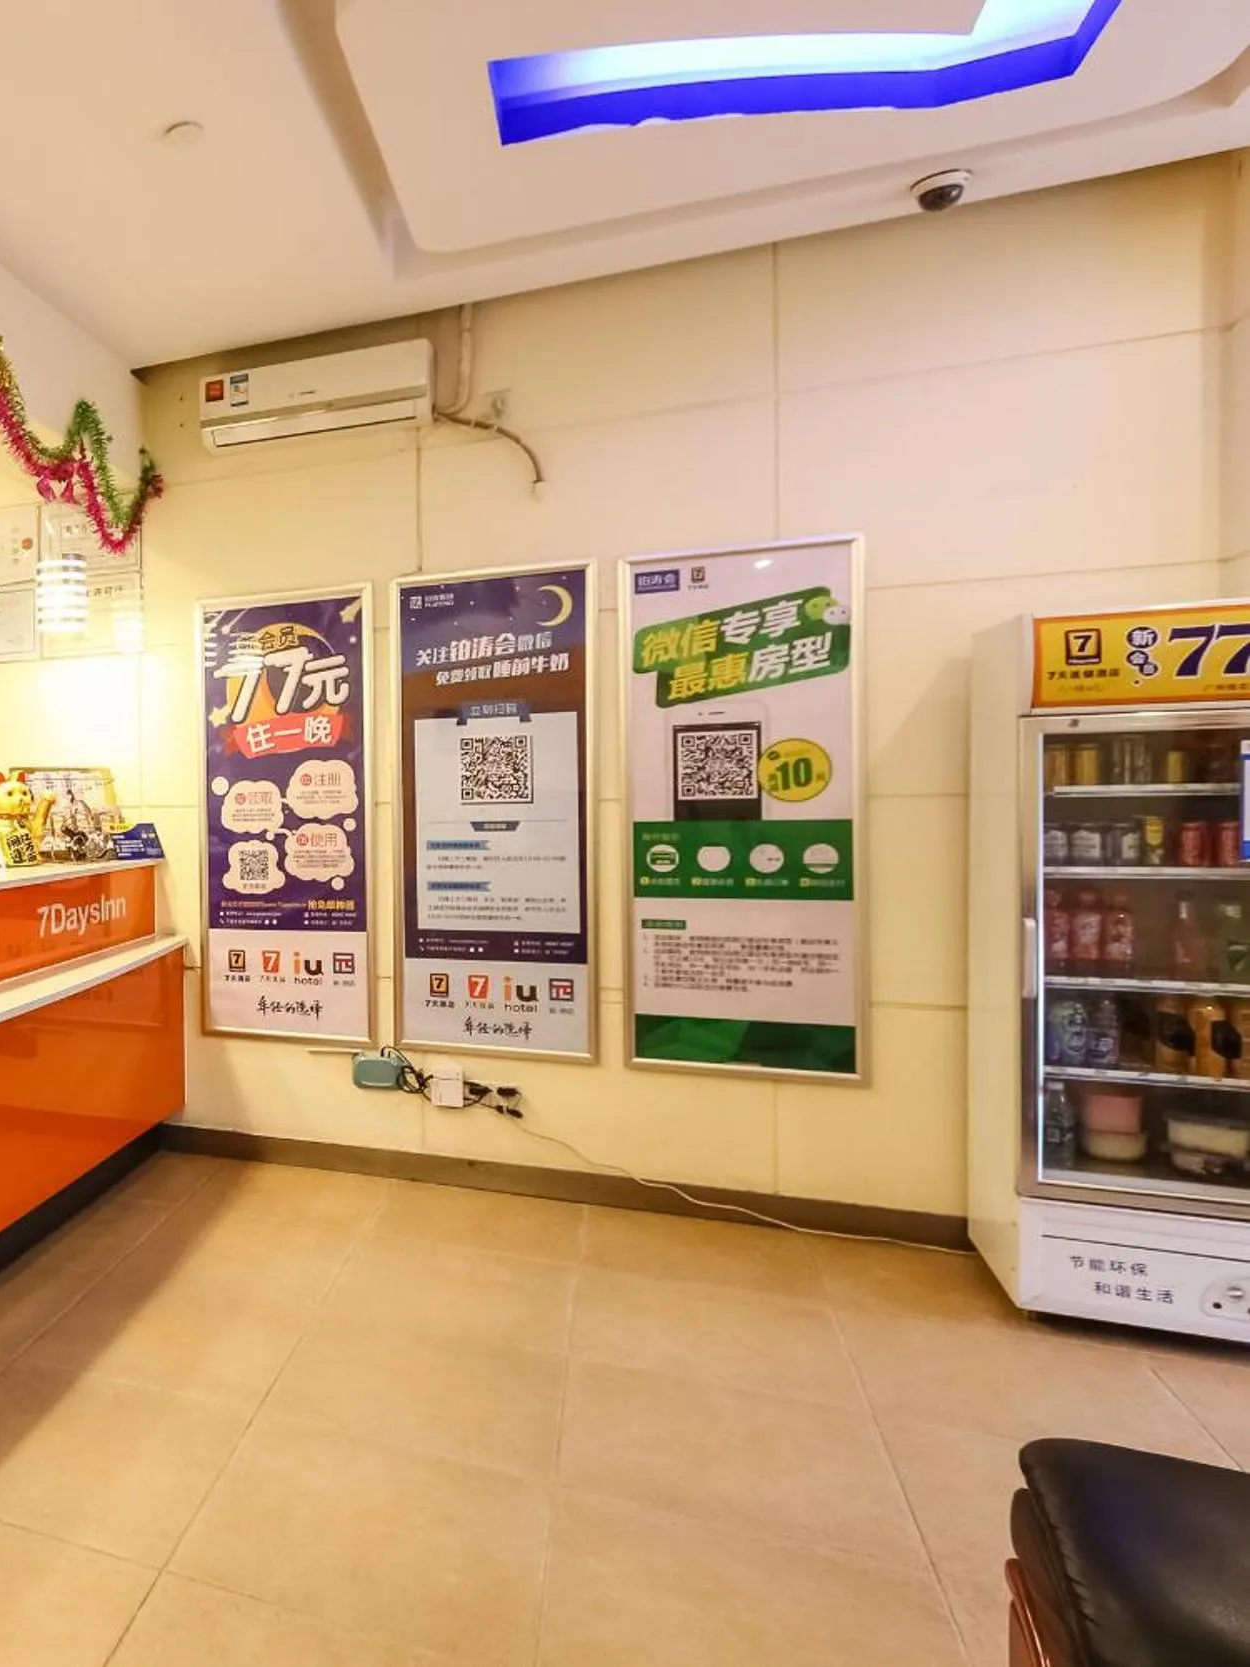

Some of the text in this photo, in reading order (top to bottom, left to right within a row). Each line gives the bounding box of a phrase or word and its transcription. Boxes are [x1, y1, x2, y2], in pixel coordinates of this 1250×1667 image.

[641, 598, 803, 668] 微信专享
[213, 646, 350, 723] 77元
[668, 631, 833, 700] 最惠房型
[245, 715, 332, 753] 住一晚
[775, 757, 813, 791] 10
[37, 893, 127, 939] 7DaysInn
[1070, 1254, 1149, 1277] 节能环保
[1094, 1280, 1174, 1305] 和谐生活
